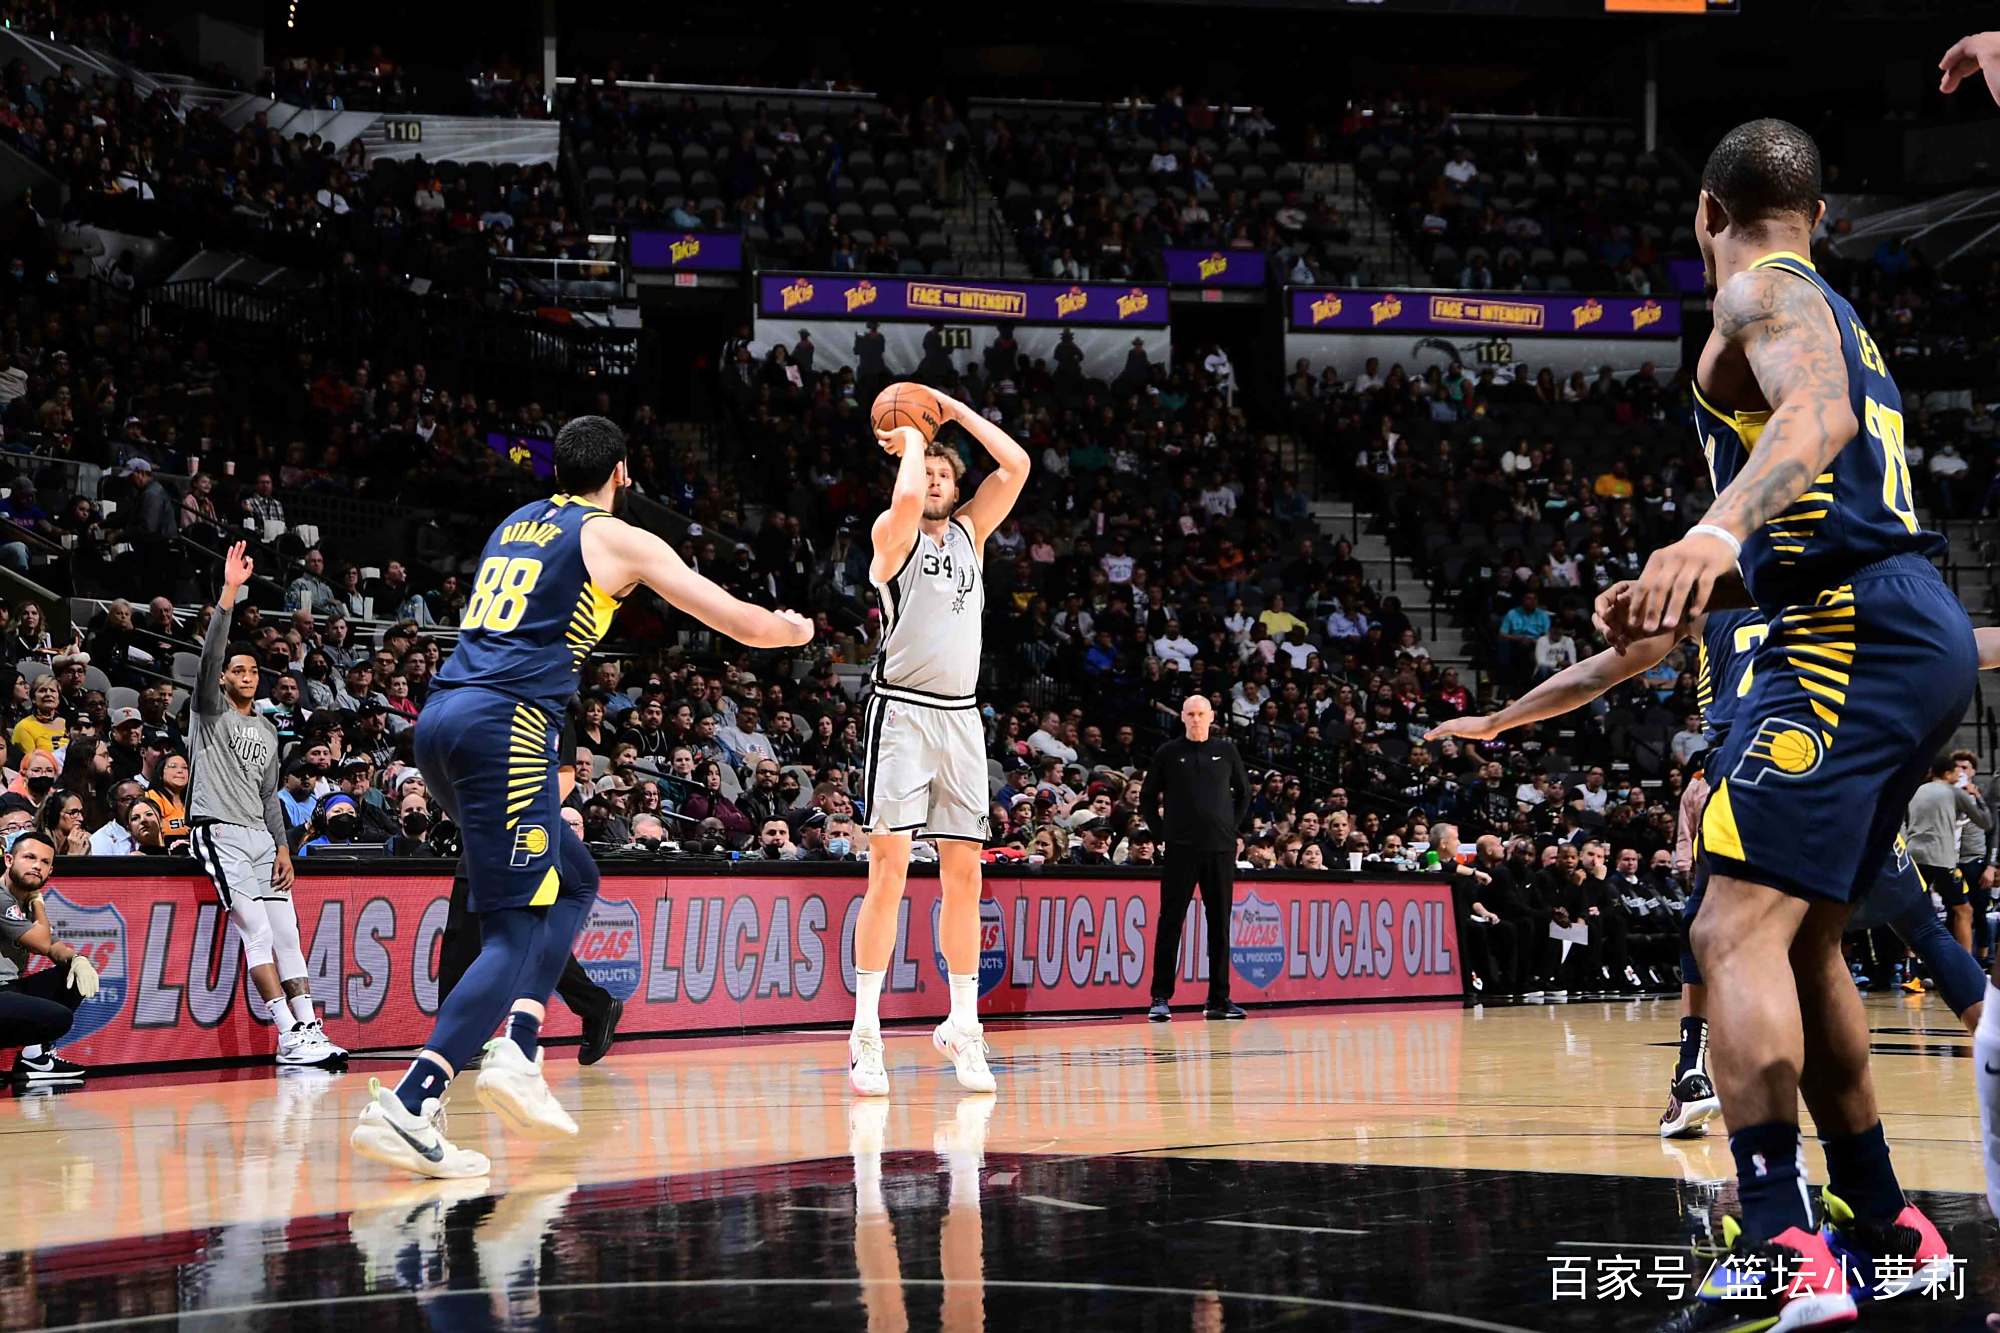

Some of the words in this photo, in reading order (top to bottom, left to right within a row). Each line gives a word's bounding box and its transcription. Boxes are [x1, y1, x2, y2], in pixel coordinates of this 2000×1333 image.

[387, 122, 420, 140] 110
[781, 284, 814, 312] Takis
[844, 285, 877, 313] Takis
[912, 287, 942, 305] FACE
[959, 290, 1022, 311] INTENSITY
[1055, 291, 1087, 318] Takis
[1116, 292, 1149, 319] Takis
[1310, 299, 1342, 325] Takis
[1370, 300, 1402, 325] Takis
[1435, 300, 1463, 318] FACE
[1479, 304, 1540, 324] INTENSITY
[1572, 304, 1603, 329] Takis
[1631, 305, 1662, 330] Takis
[938, 329, 968, 347] 111
[1480, 345, 1511, 362] 112
[923, 554, 953, 579] 34
[460, 556, 543, 632] 88
[645, 893, 829, 1004] LUCAS
[1010, 895, 1147, 989] LUCAS
[1288, 898, 1394, 980] LUCAS
[1402, 898, 1451, 979] OIL
